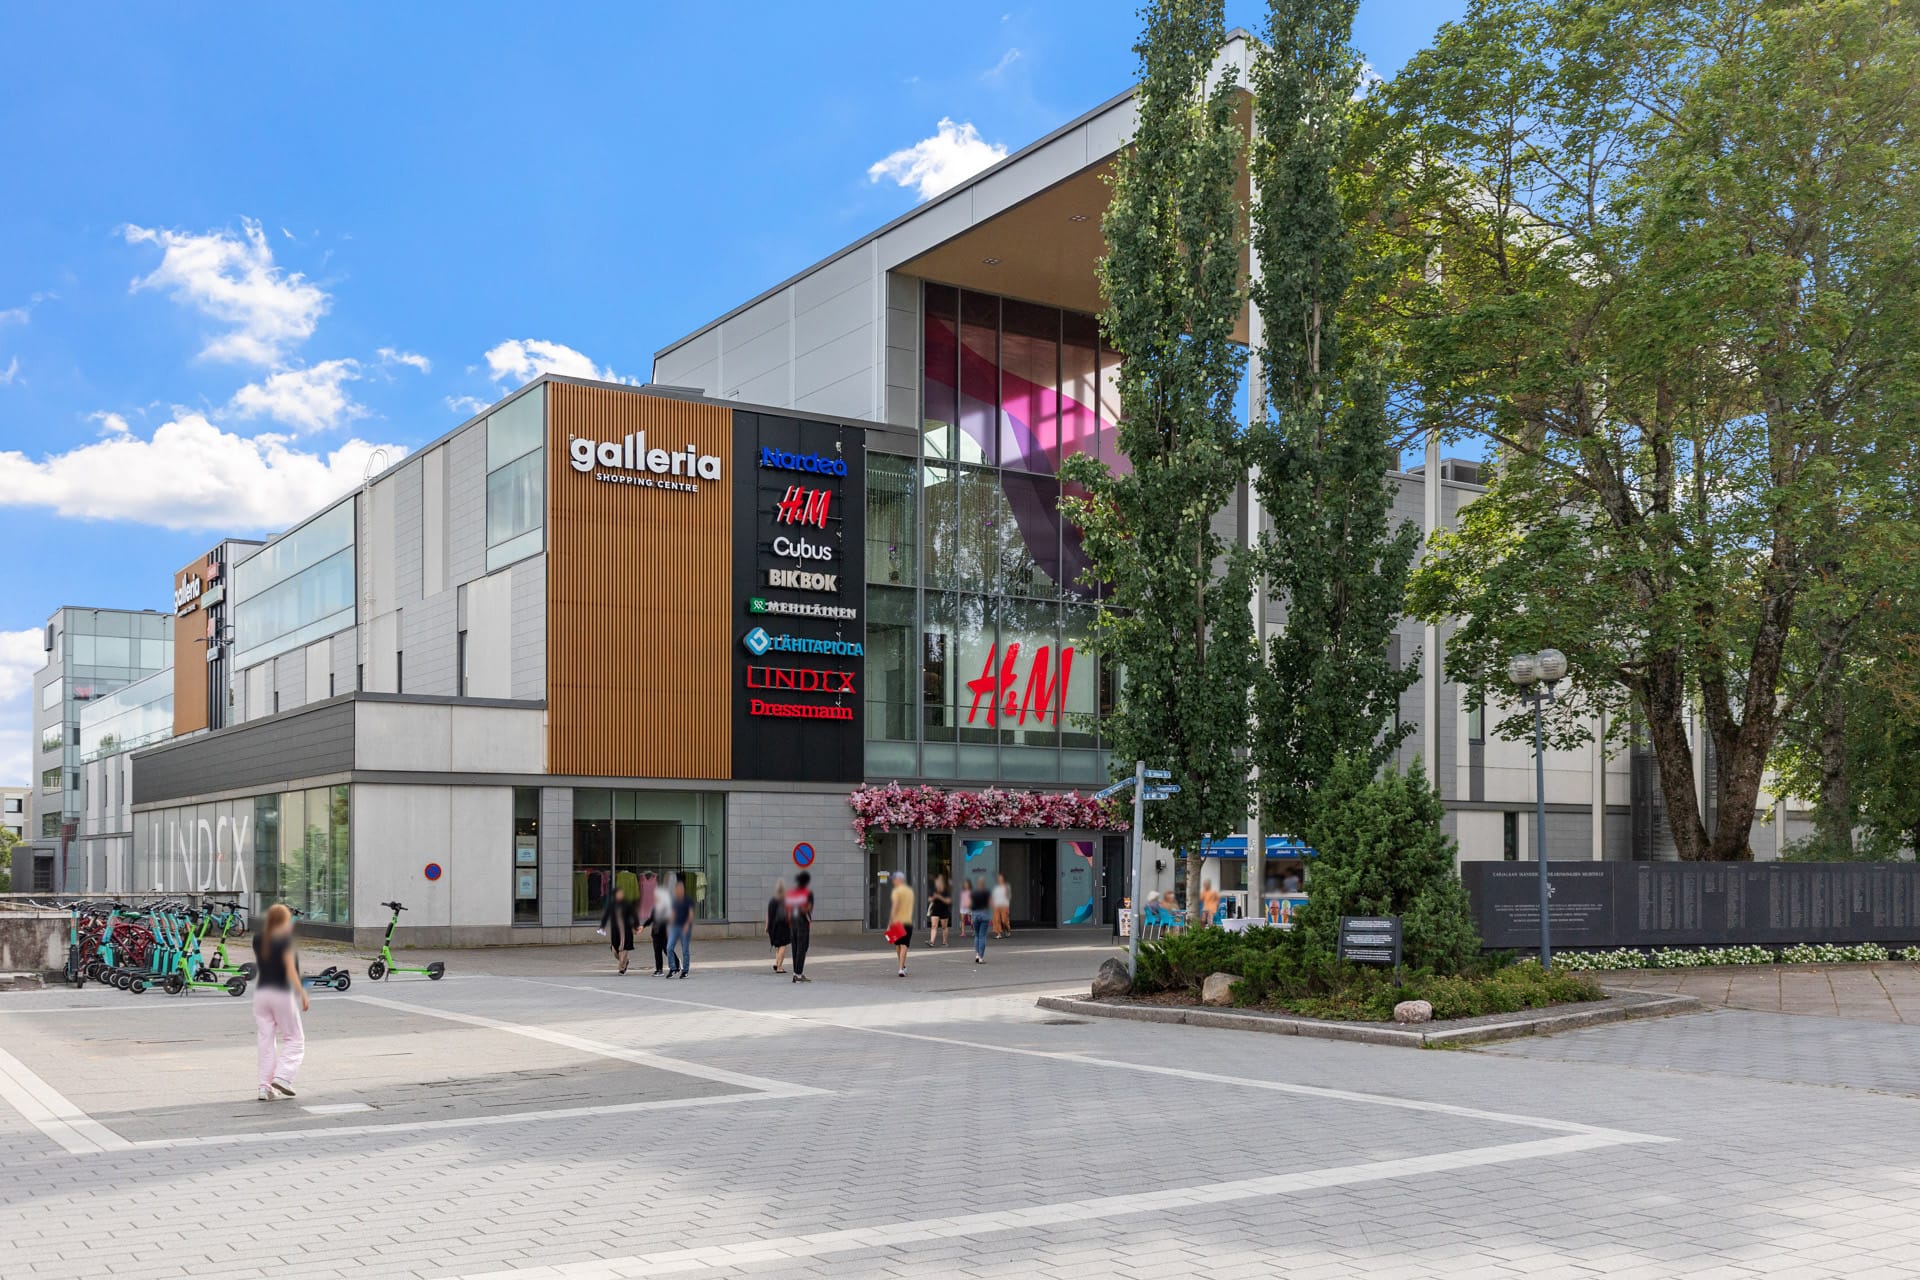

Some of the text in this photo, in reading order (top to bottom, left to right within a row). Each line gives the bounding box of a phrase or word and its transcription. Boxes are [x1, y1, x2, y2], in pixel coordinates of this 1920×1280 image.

[571, 431, 721, 480] galleria
[762, 447, 847, 476] Nordea
[596, 472, 698, 492] SHOPPING CENTRE
[777, 486, 832, 528] H&M
[773, 537, 832, 560] Cubus
[769, 569, 837, 592] BIKBOK
[767, 601, 857, 619] MEHILÄINEN
[774, 635, 864, 657] LÄHITAPIOLA
[747, 665, 856, 693] LINDEX
[967, 642, 1075, 729] H&M
[750, 699, 853, 720] Dressmann
[154, 815, 249, 894] LINDEX
